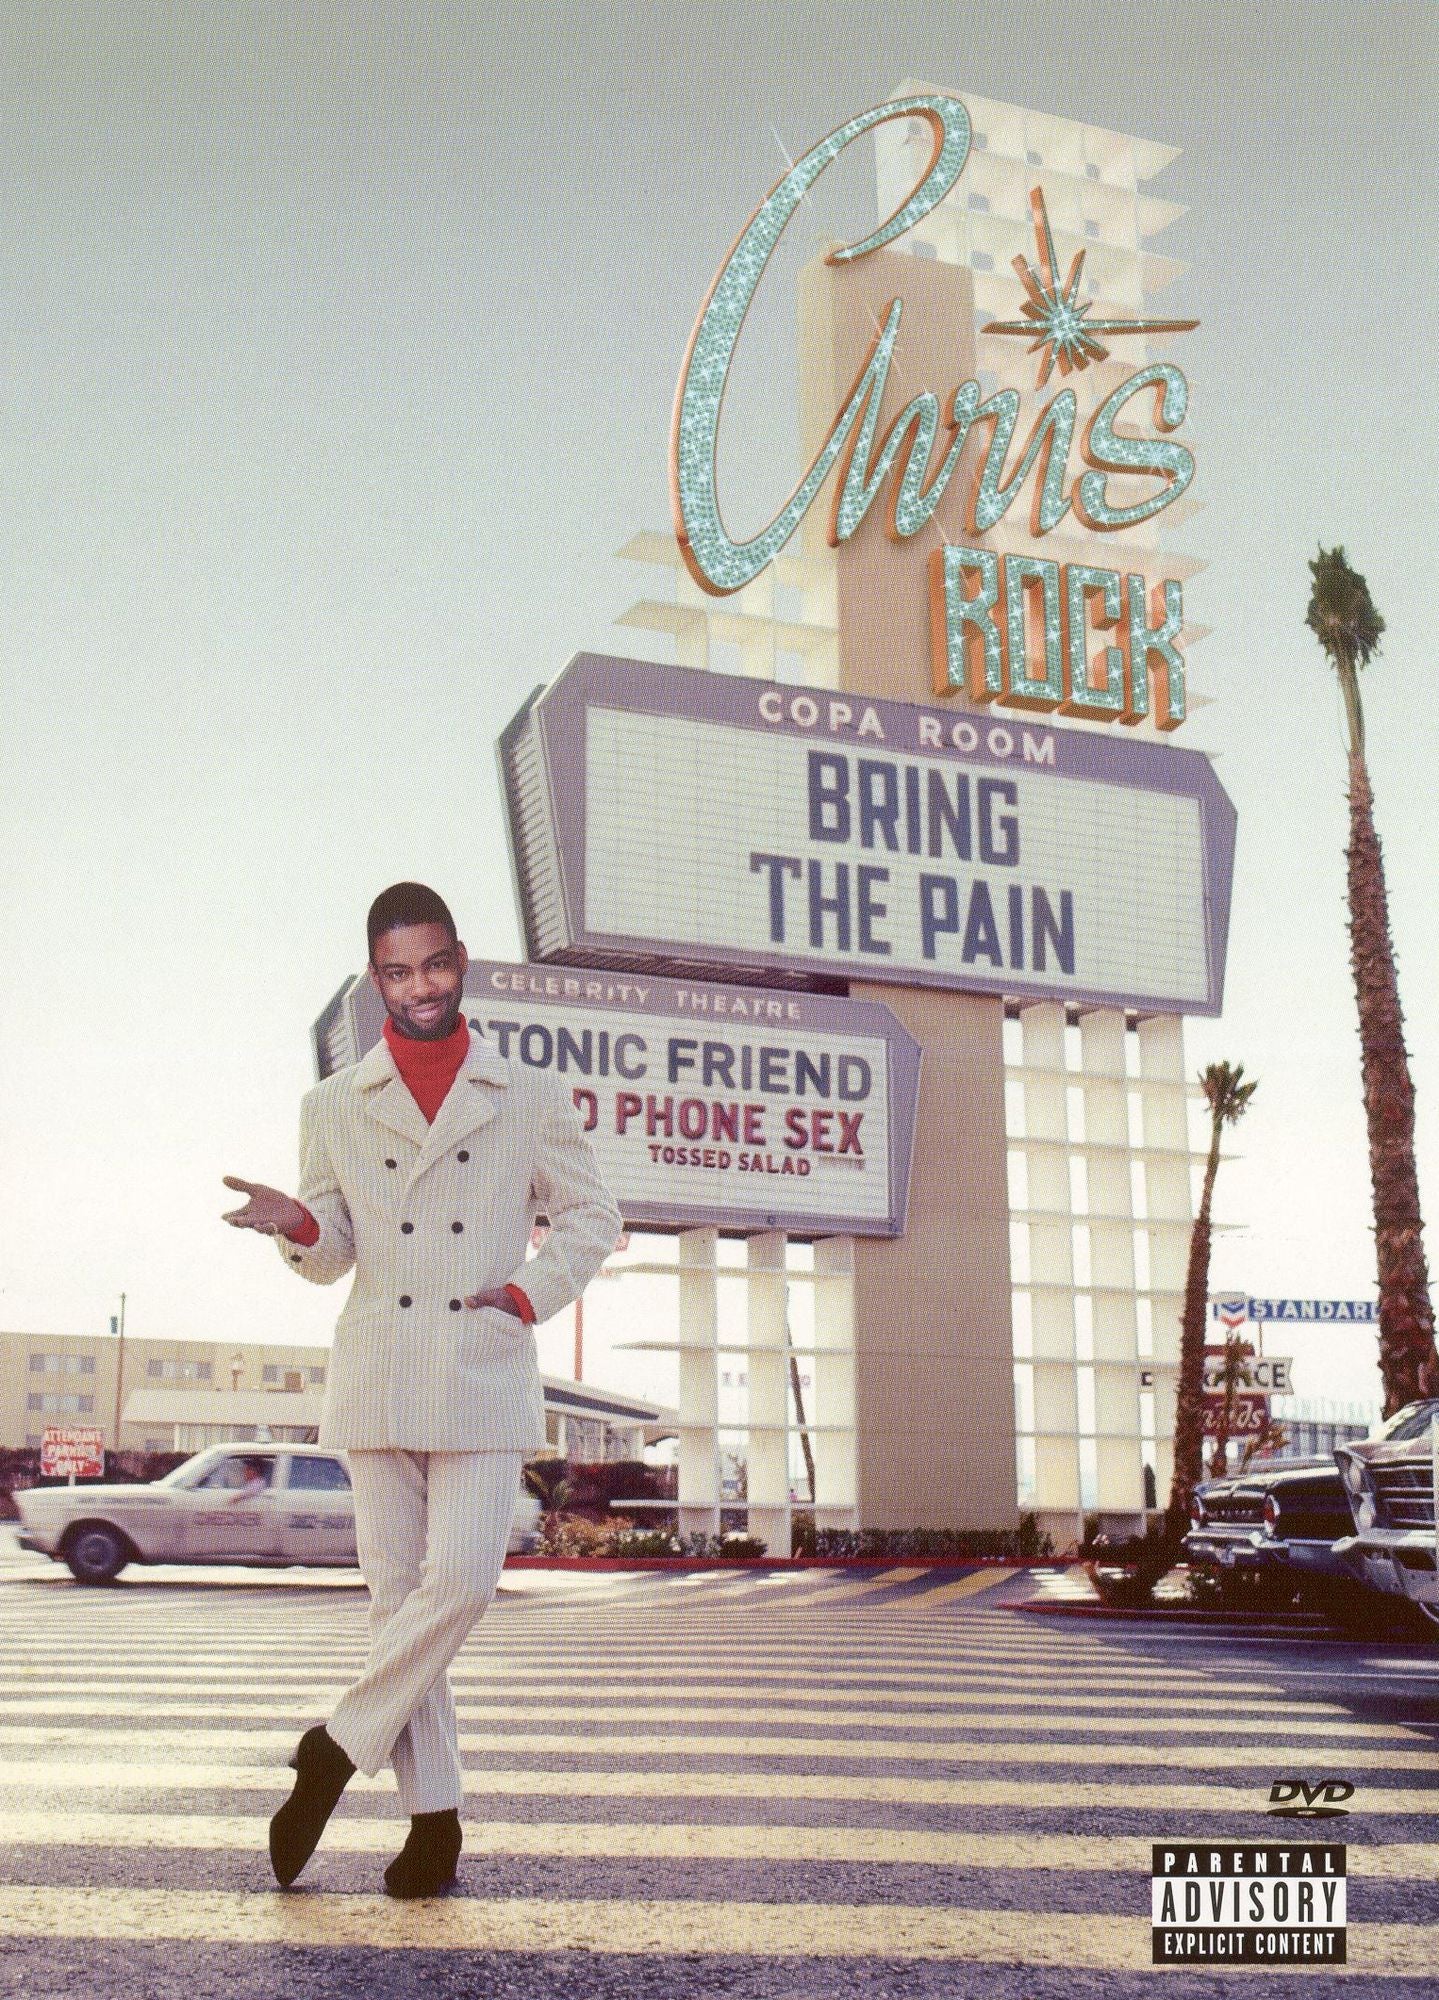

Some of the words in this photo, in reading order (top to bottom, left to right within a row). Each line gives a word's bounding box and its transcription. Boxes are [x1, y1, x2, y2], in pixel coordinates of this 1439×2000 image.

[670, 95, 1196, 596] Chris
[928, 545, 1187, 731] ROCK
[758, 691, 885, 740] COPA
[919, 716, 1055, 765] ROOM
[808, 750, 1020, 867] BRING
[750, 852, 891, 955] THE
[919, 873, 1076, 975] PAIN
[491, 971, 649, 1004] CELEBRITY
[676, 990, 801, 1020] THEATRE
[667, 1038, 872, 1101] FRIEND
[615, 1091, 767, 1146] PHONE
[784, 1107, 864, 1155] SEX
[648, 1144, 732, 1169] TOSSED
[738, 1152, 811, 1176] SALAD
